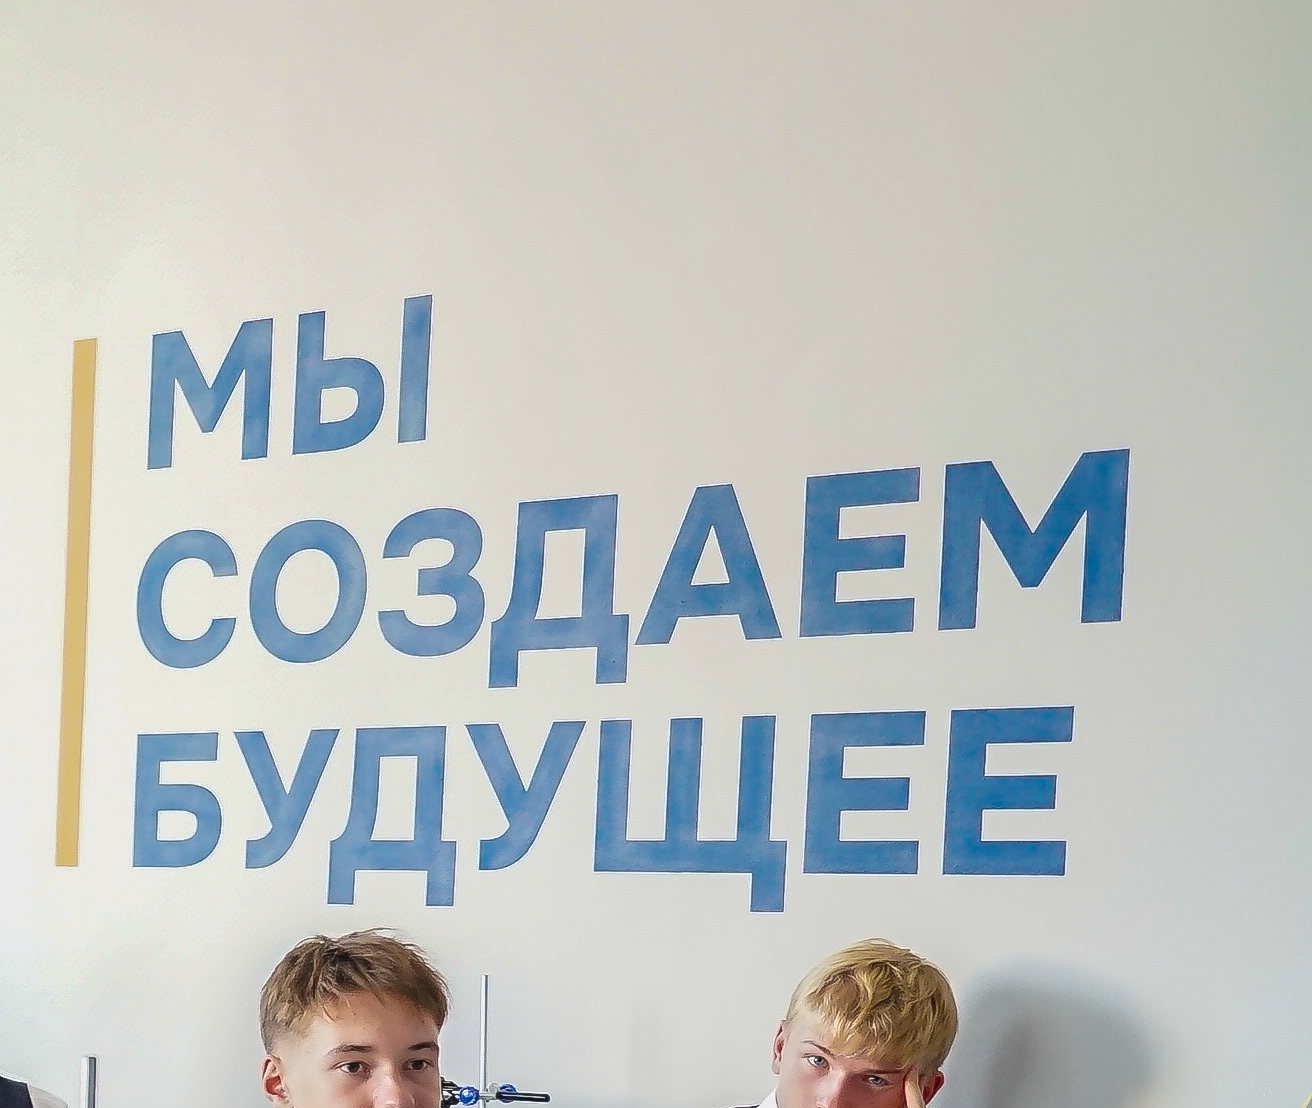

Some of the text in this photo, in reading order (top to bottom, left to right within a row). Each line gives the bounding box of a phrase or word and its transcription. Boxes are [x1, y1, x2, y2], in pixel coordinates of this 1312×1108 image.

[147, 294, 433, 470] МЫ
[136, 448, 1131, 689] СОЗДАЕМ
[132, 705, 1076, 913] БУДУЩЕЕ
